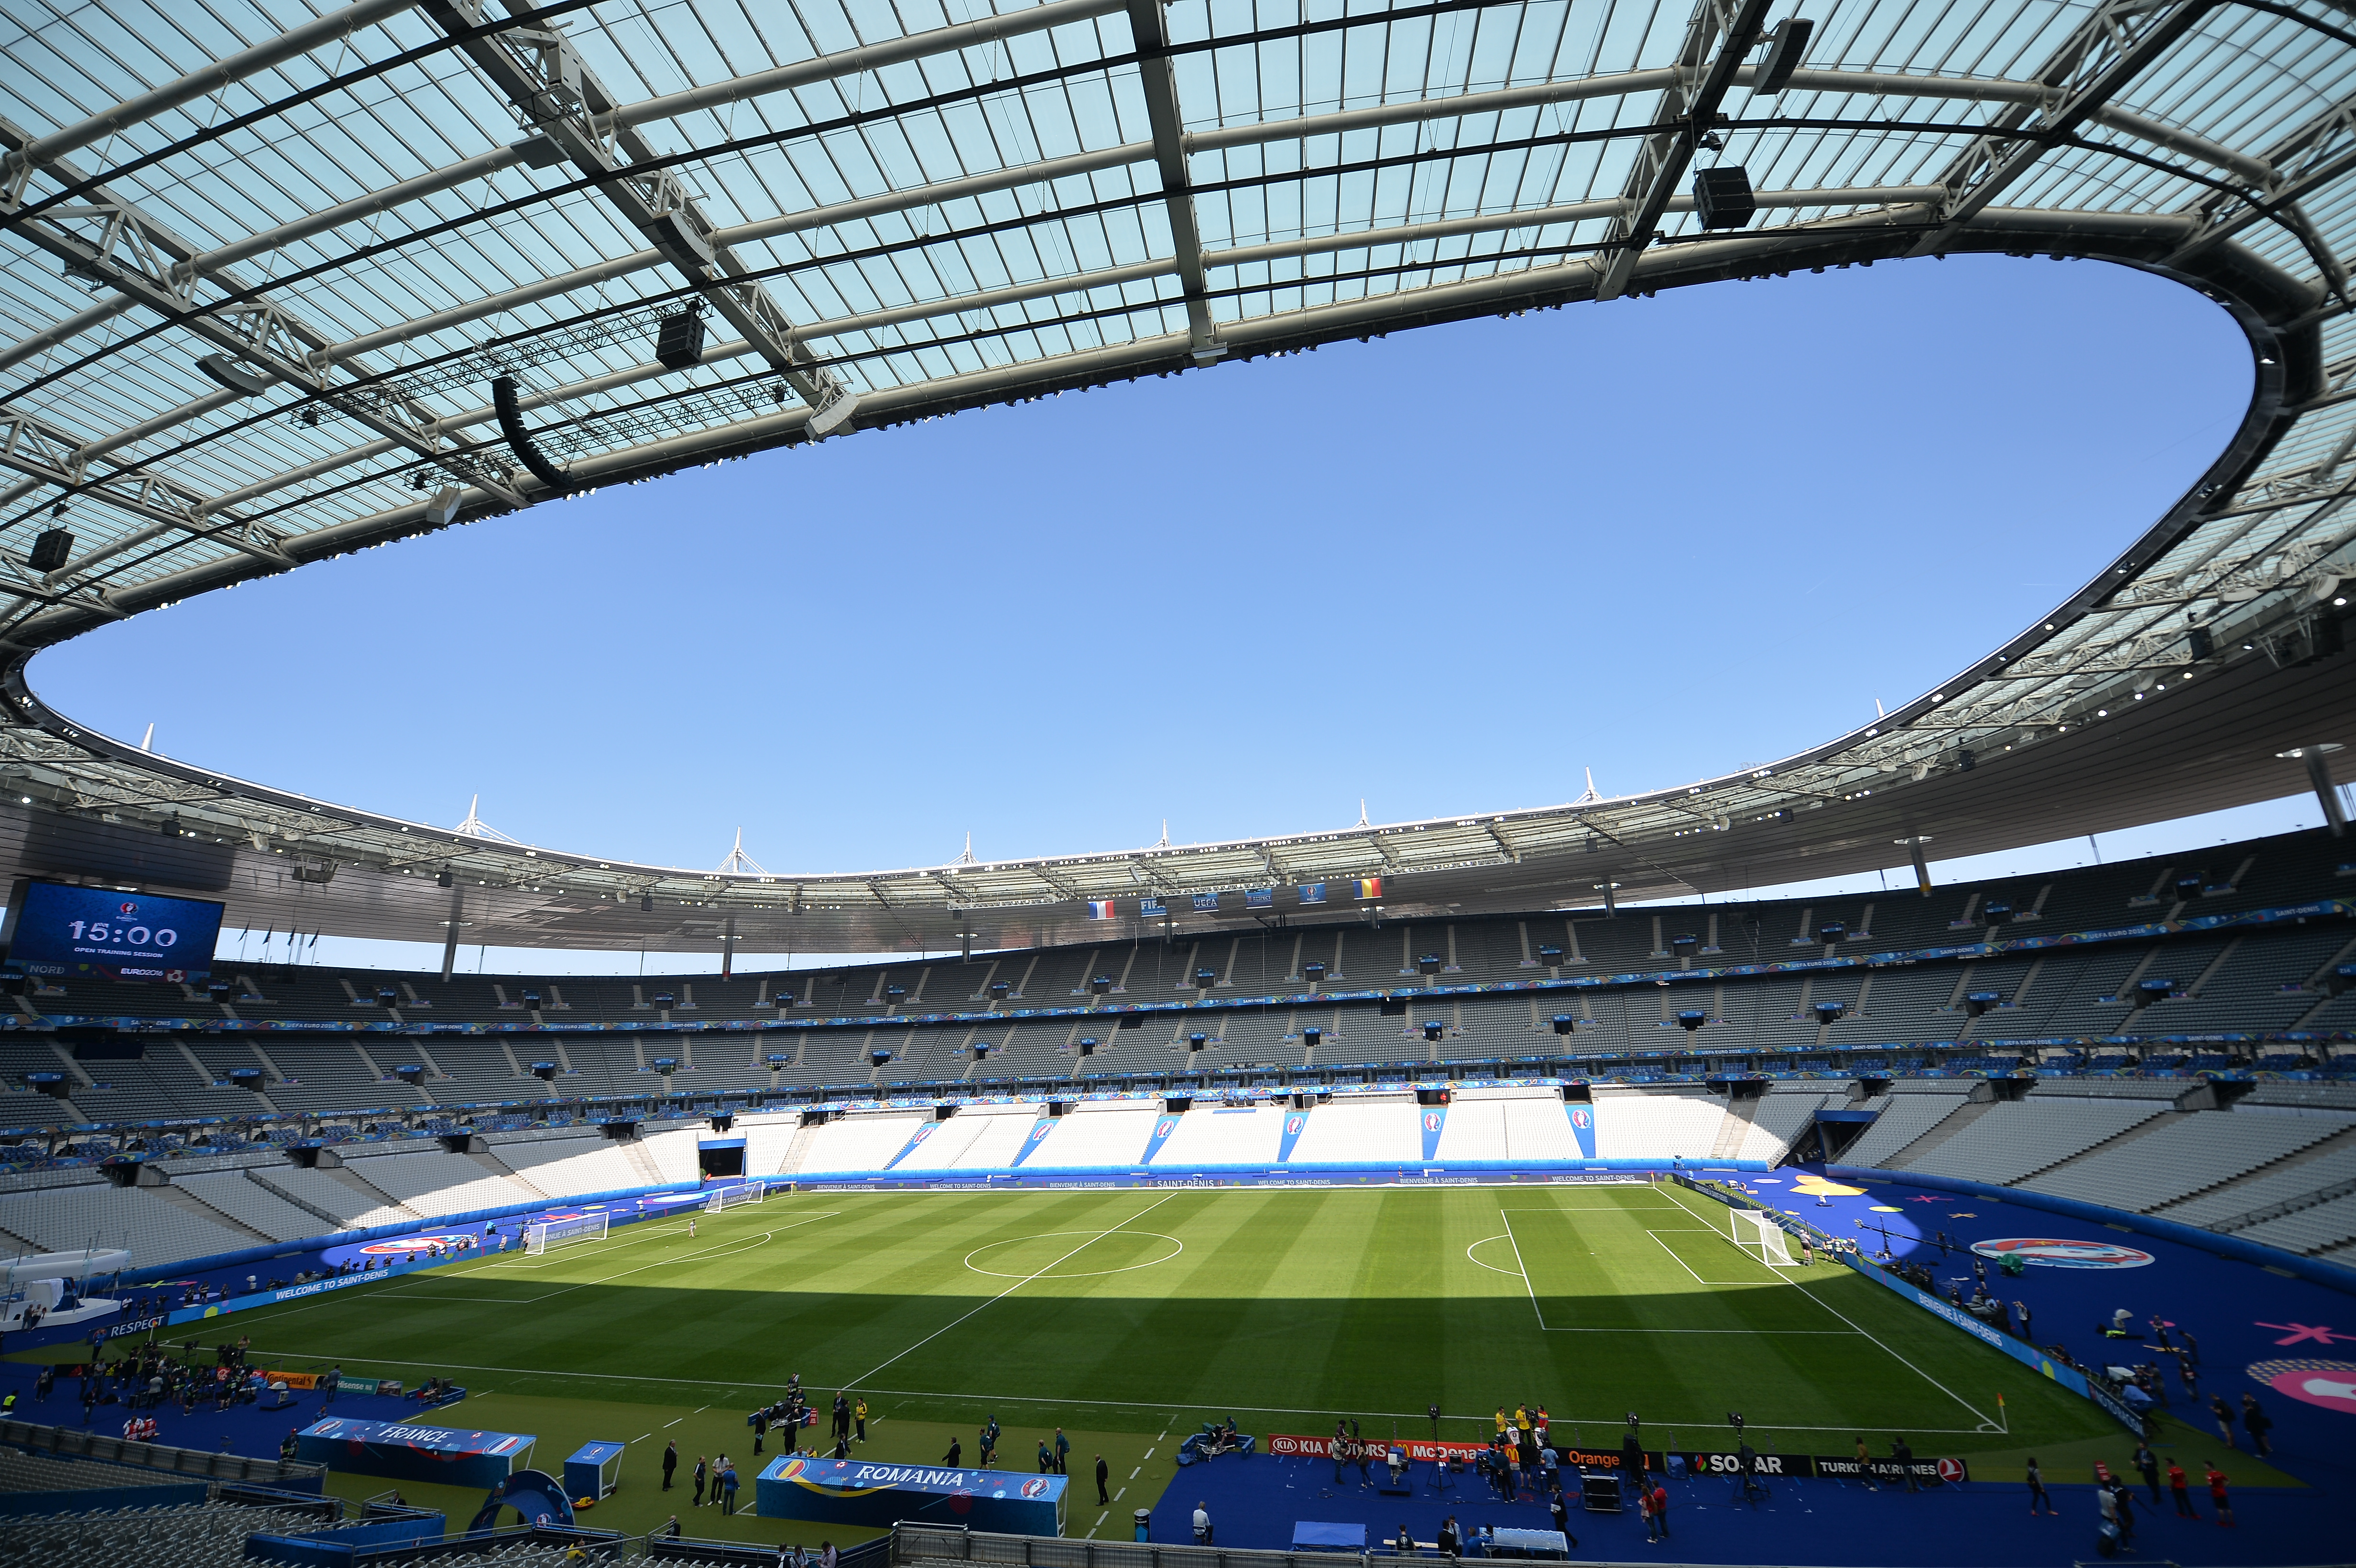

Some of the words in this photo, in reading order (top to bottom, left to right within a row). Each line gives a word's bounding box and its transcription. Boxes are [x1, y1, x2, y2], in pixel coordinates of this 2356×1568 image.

[1194, 899, 1217, 907] UEFA
[2275, 905, 2320, 917] SAINT-DENIS
[68, 921, 177, 946] 15:00
[29, 965, 65, 974] NORD
[275, 1283, 322, 1300] WELCOME
[324, 1281, 336, 1290] TO
[337, 1269, 389, 1287] SAINT-DENIS
[110, 1316, 164, 1337] RESPECT
[1918, 1293, 1952, 1319] BIENVENUE
[1958, 1315, 2003, 1347] SAINT-DENIS
[267, 1373, 306, 1386] Continental
[337, 1381, 364, 1390] Hisense
[377, 1426, 455, 1443] FRANCE
[1276, 1440, 1293, 1450] KIA
[1300, 1440, 1324, 1454] KIA
[1569, 1450, 1620, 1468] Orange
[1710, 1455, 1783, 1473] SOAR
[1819, 1462, 1876, 1474] TURKIH
[854, 1466, 963, 1487] ROMANIA
